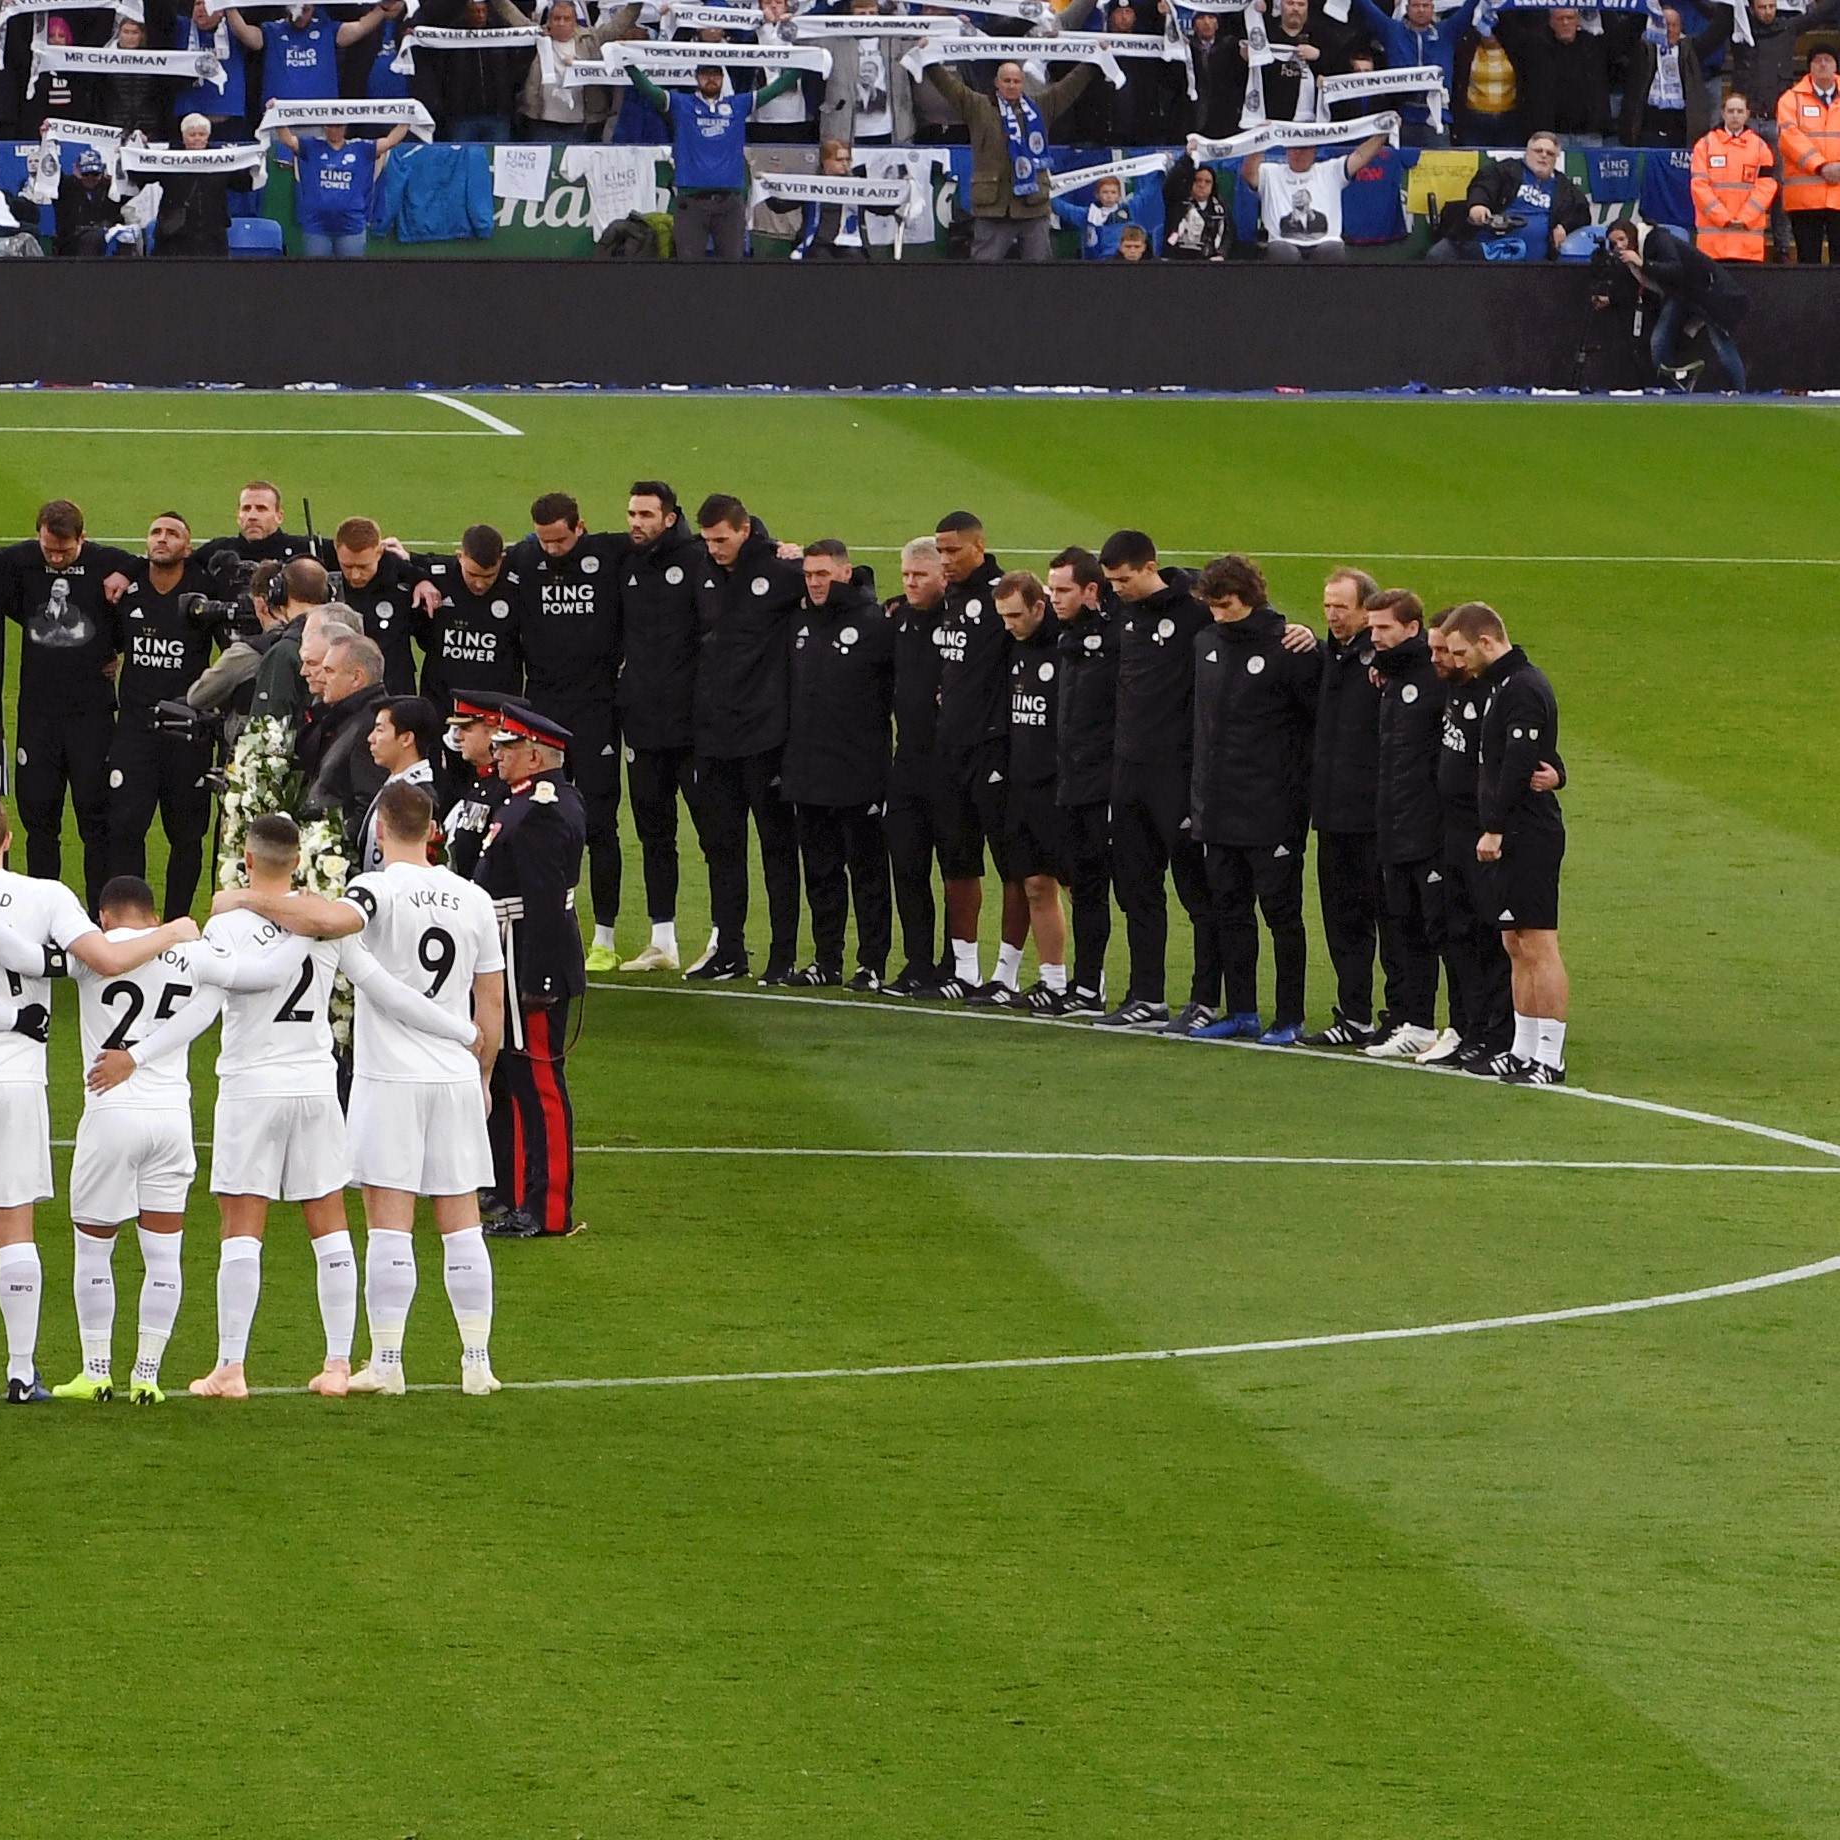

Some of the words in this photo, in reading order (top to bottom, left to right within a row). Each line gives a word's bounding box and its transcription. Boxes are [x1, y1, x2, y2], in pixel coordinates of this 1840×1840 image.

[65, 52, 83, 62] MR
[88, 53, 167, 66] CHAIRMAN
[286, 48, 316, 59] KING
[644, 49, 694, 58] FOREVER
[697, 49, 713, 58] IN
[717, 49, 741, 58] OUR
[745, 49, 790, 59] HEARTS
[287, 58, 316, 66] POWER
[1254, 133, 1270, 145] MR
[1274, 126, 1348, 139] CHAIRMAN
[140, 156, 158, 164] MR
[162, 155, 234, 164] CHAIRMAN
[506, 151, 536, 162] KING
[506, 161, 535, 169] POWER
[1599, 160, 1629, 173] KING
[320, 170, 352, 181] KING
[605, 170, 636, 180] KING
[1601, 170, 1629, 178] POWER
[320, 179, 350, 189] POWER
[1518, 185, 1549, 200] KING
[541, 584, 594, 601] KING
[542, 602, 594, 615] POWER
[443, 629, 497, 649] KING
[133, 636, 184, 656] KING
[442, 646, 495, 663] POWER
[133, 654, 182, 670] POWER
[418, 926, 456, 998] 9
[273, 953, 314, 1023] 2
[101, 980, 193, 1050] 25
